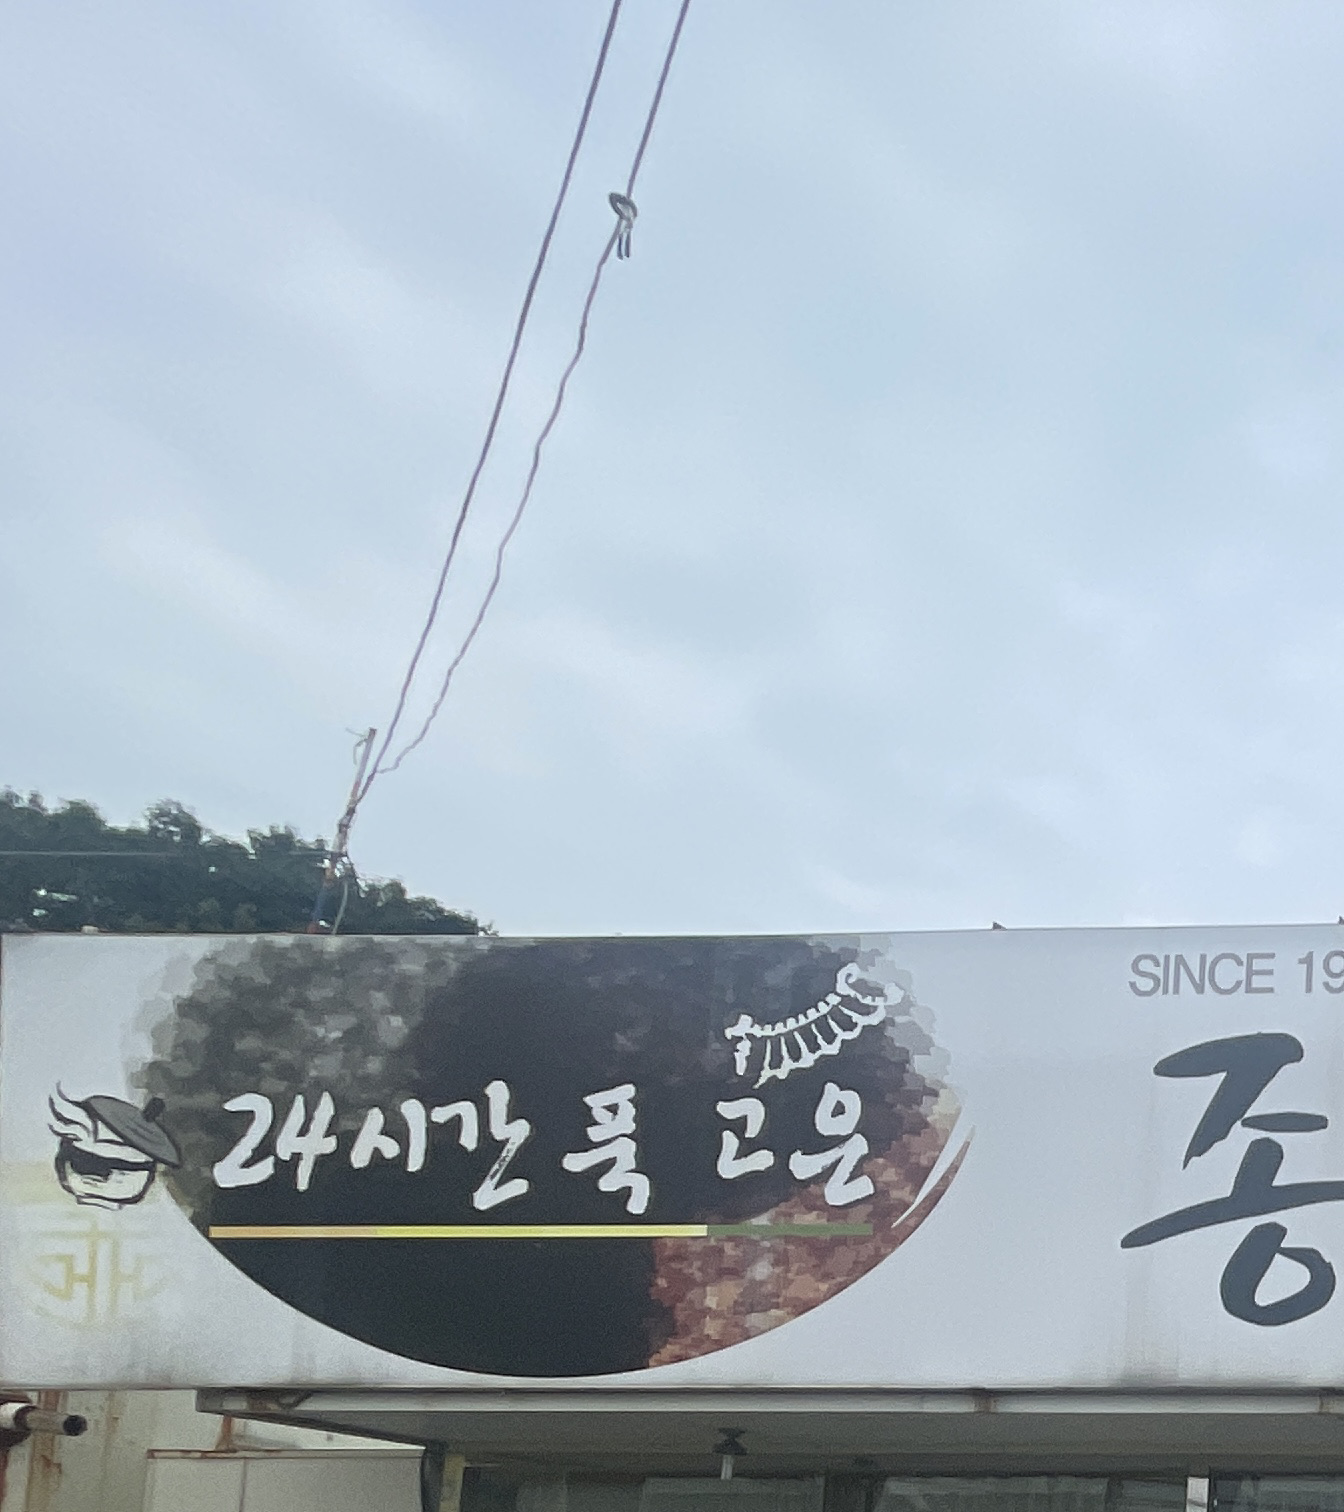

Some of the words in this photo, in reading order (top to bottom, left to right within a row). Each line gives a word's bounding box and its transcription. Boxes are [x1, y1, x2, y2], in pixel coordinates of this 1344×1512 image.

[1128, 950, 1276, 998] SINCE
[212, 1079, 531, 1212] 24시간
[561, 1082, 651, 1216] 푹
